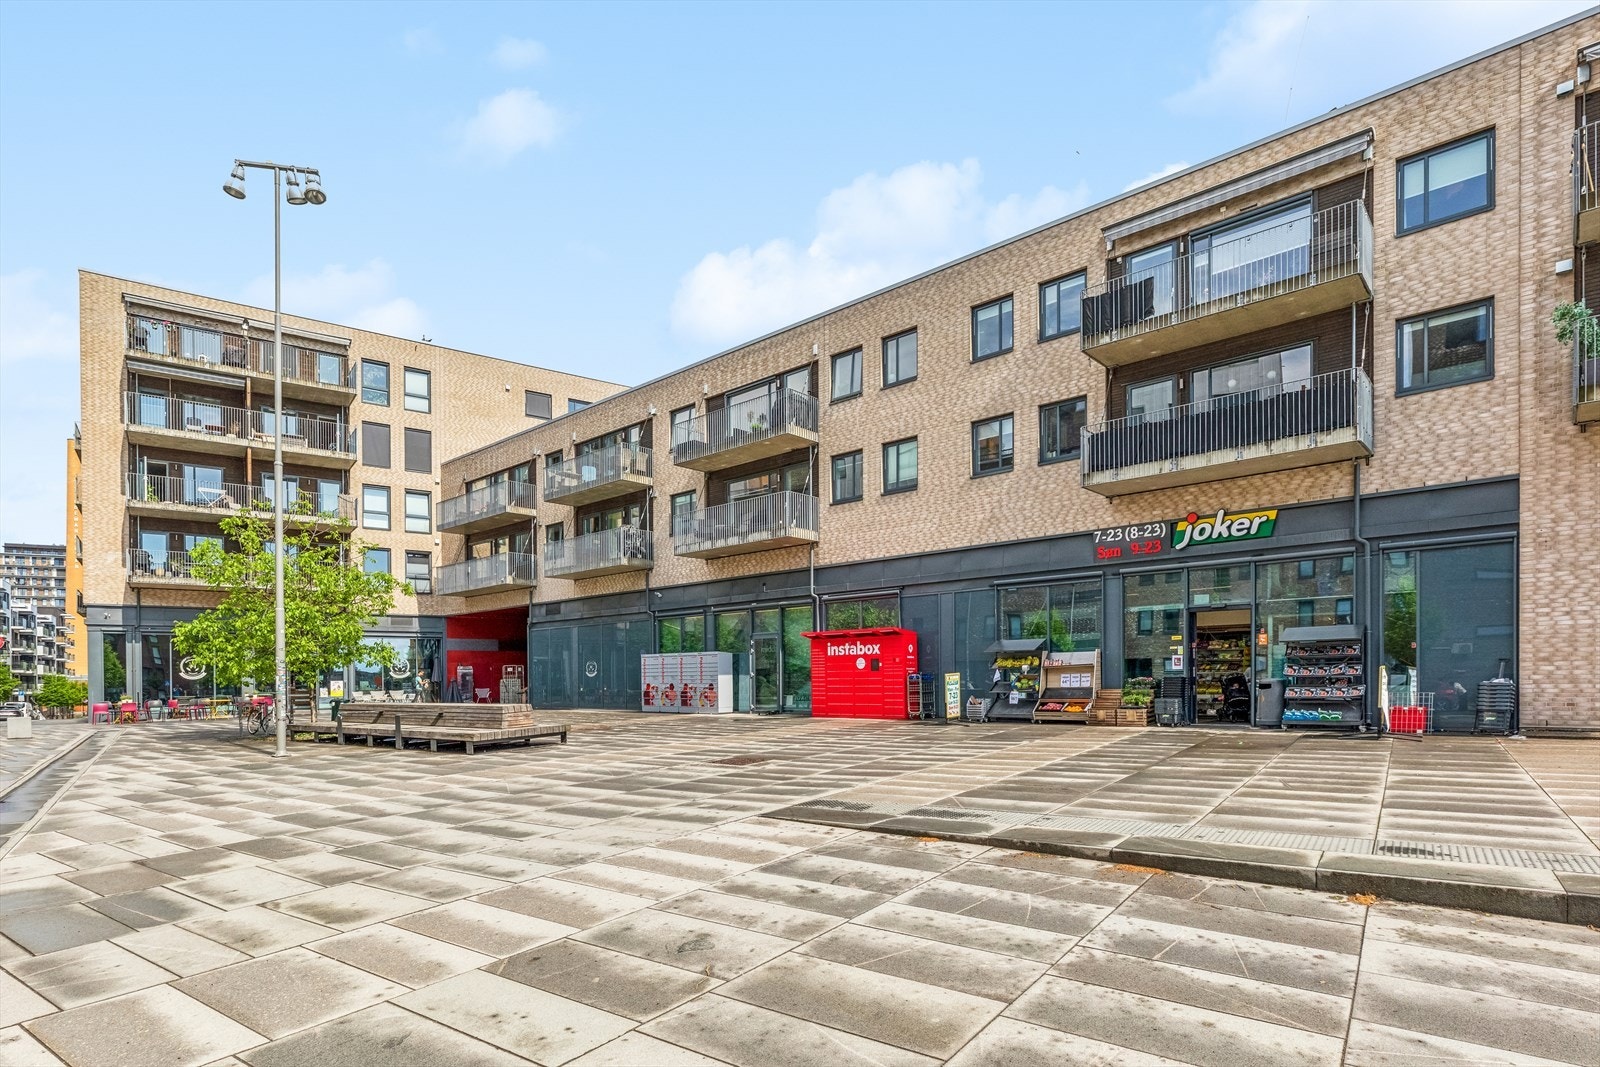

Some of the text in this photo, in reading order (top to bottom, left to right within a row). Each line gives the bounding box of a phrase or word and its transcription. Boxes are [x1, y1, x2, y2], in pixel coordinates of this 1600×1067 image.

[1094, 522, 1166, 544] 7-23 (8-23)
[1175, 508, 1268, 550] joker
[1130, 539, 1162, 555] 9-23
[827, 641, 881, 656] instabox
